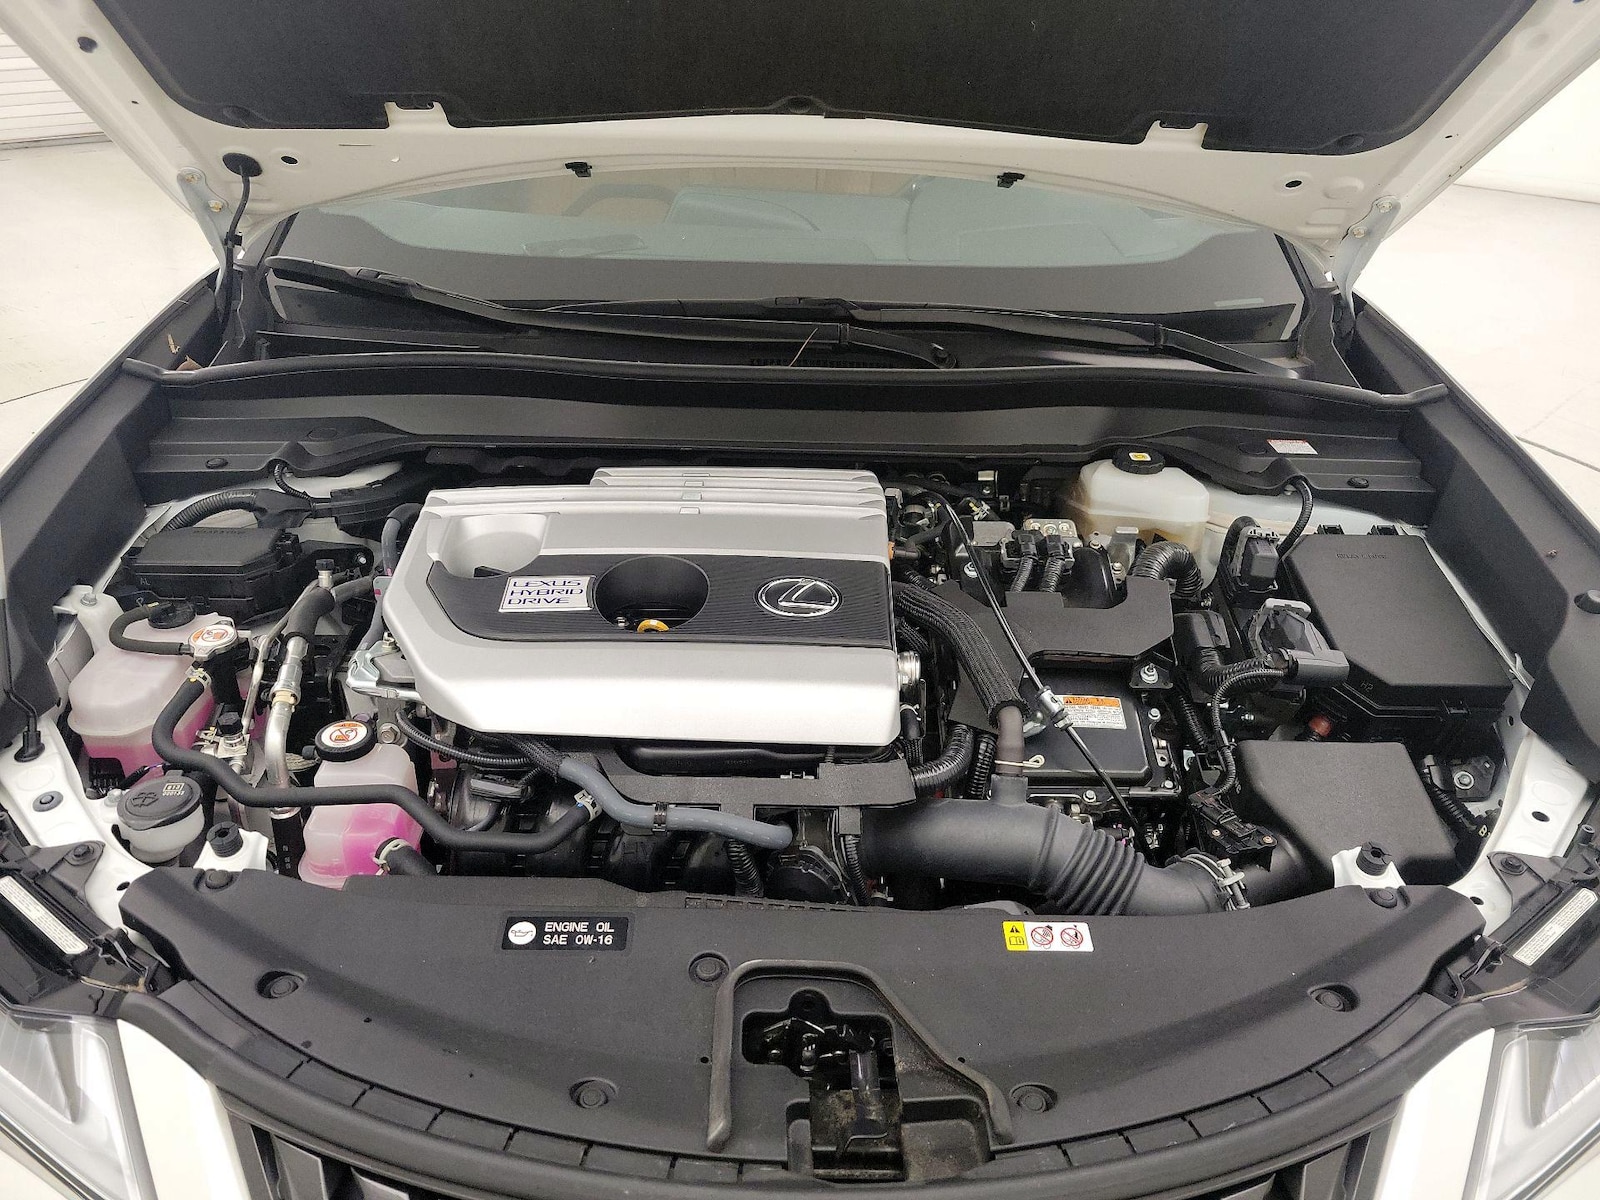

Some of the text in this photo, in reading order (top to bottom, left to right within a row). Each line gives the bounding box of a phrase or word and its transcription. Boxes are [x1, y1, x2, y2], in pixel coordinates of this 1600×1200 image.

[510, 588, 583, 596] HYBRID
[507, 597, 570, 605] DRIVE
[544, 921, 615, 932] ENGINE OIL
[542, 935, 614, 945] SAE 0W-16
